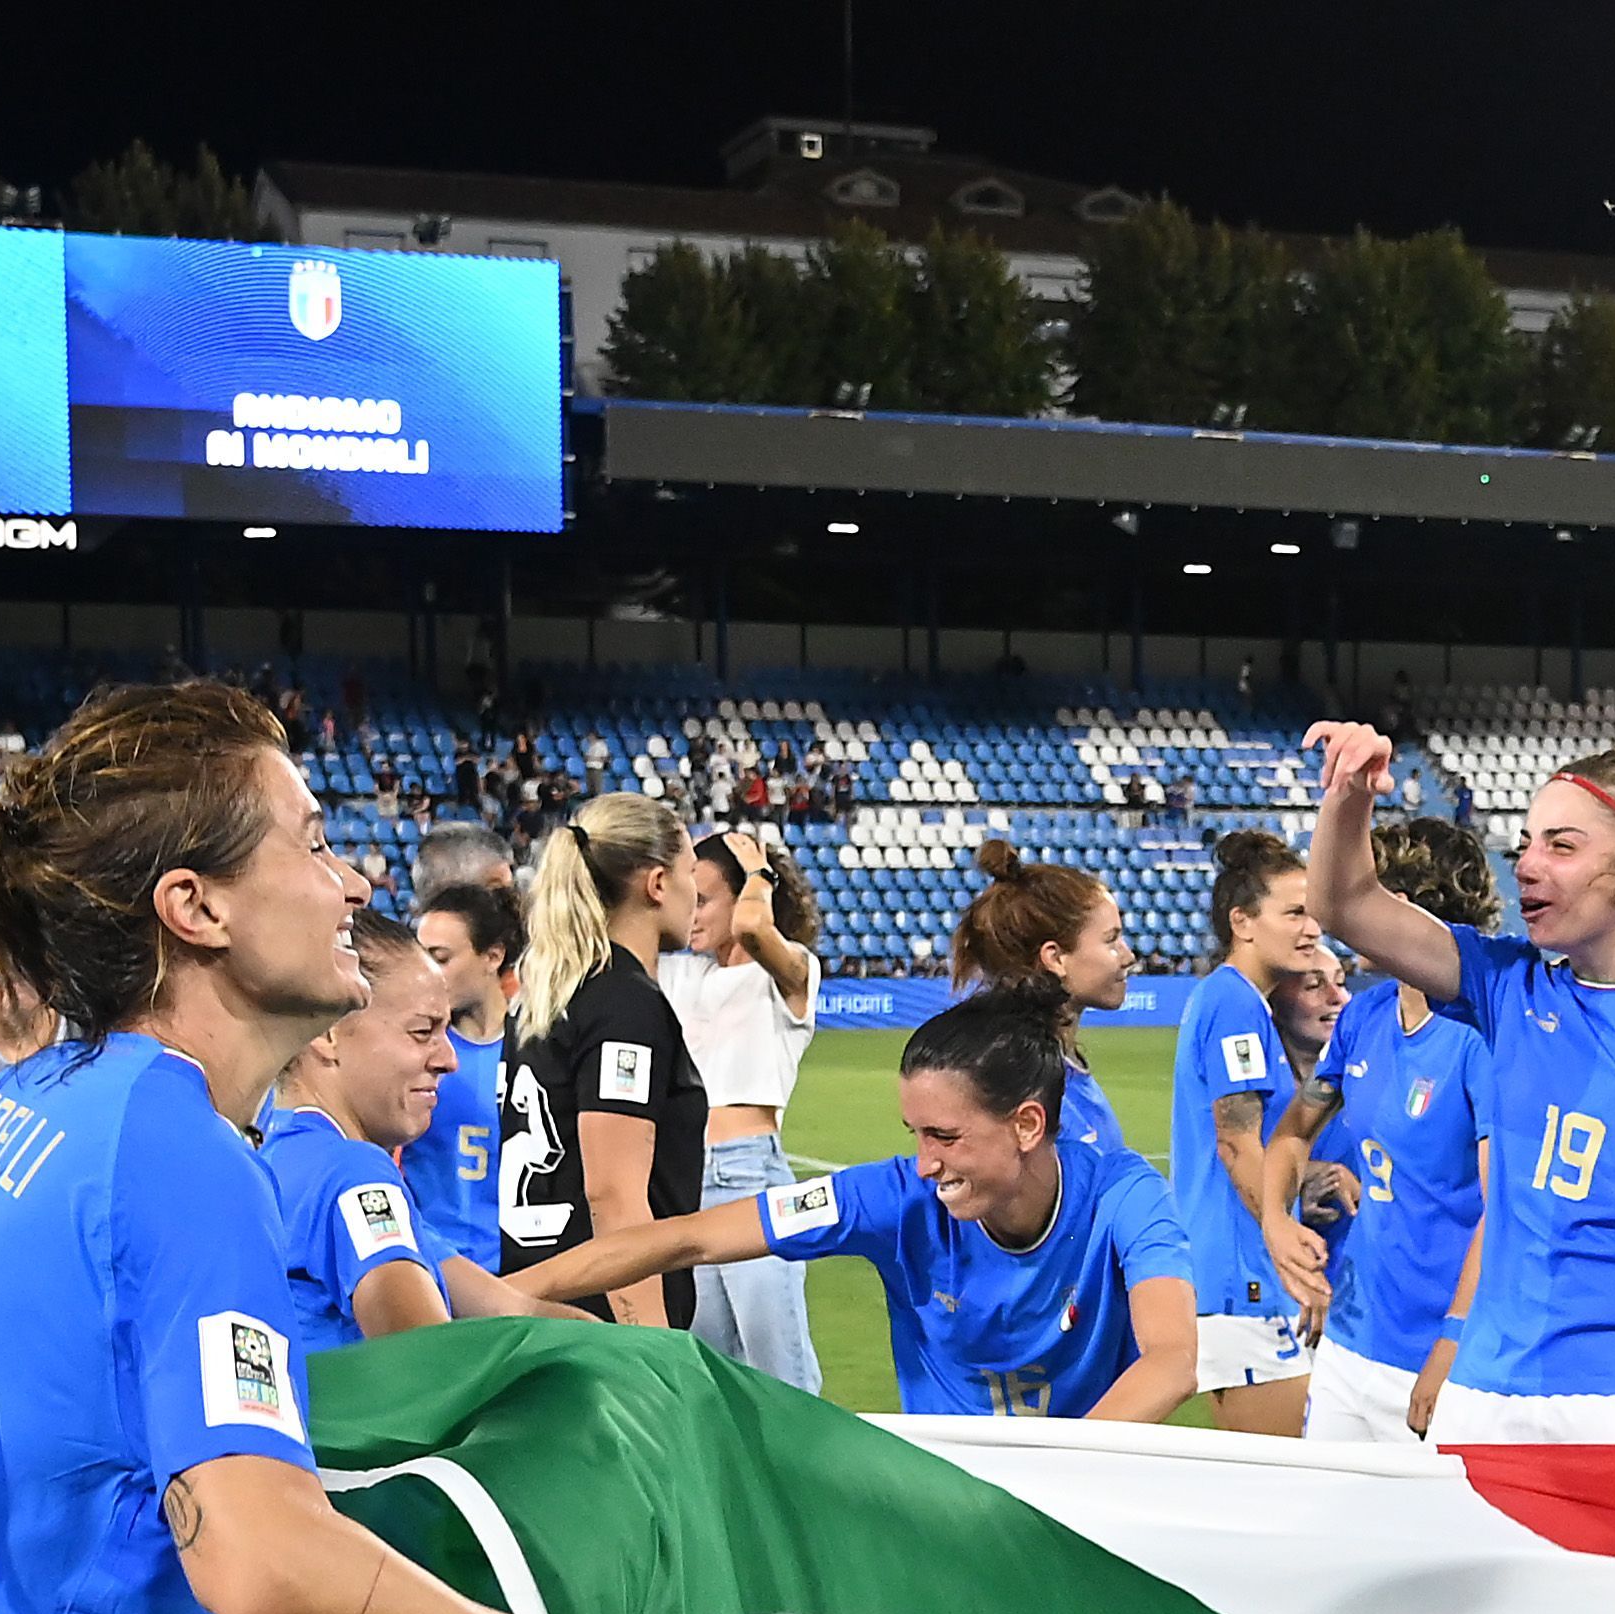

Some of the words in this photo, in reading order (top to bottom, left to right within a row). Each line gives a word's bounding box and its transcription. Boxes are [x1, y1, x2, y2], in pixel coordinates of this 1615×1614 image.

[457, 1125, 491, 1181] 5
[1360, 1137, 1394, 1203] 9
[1532, 1104, 1606, 1201] 19
